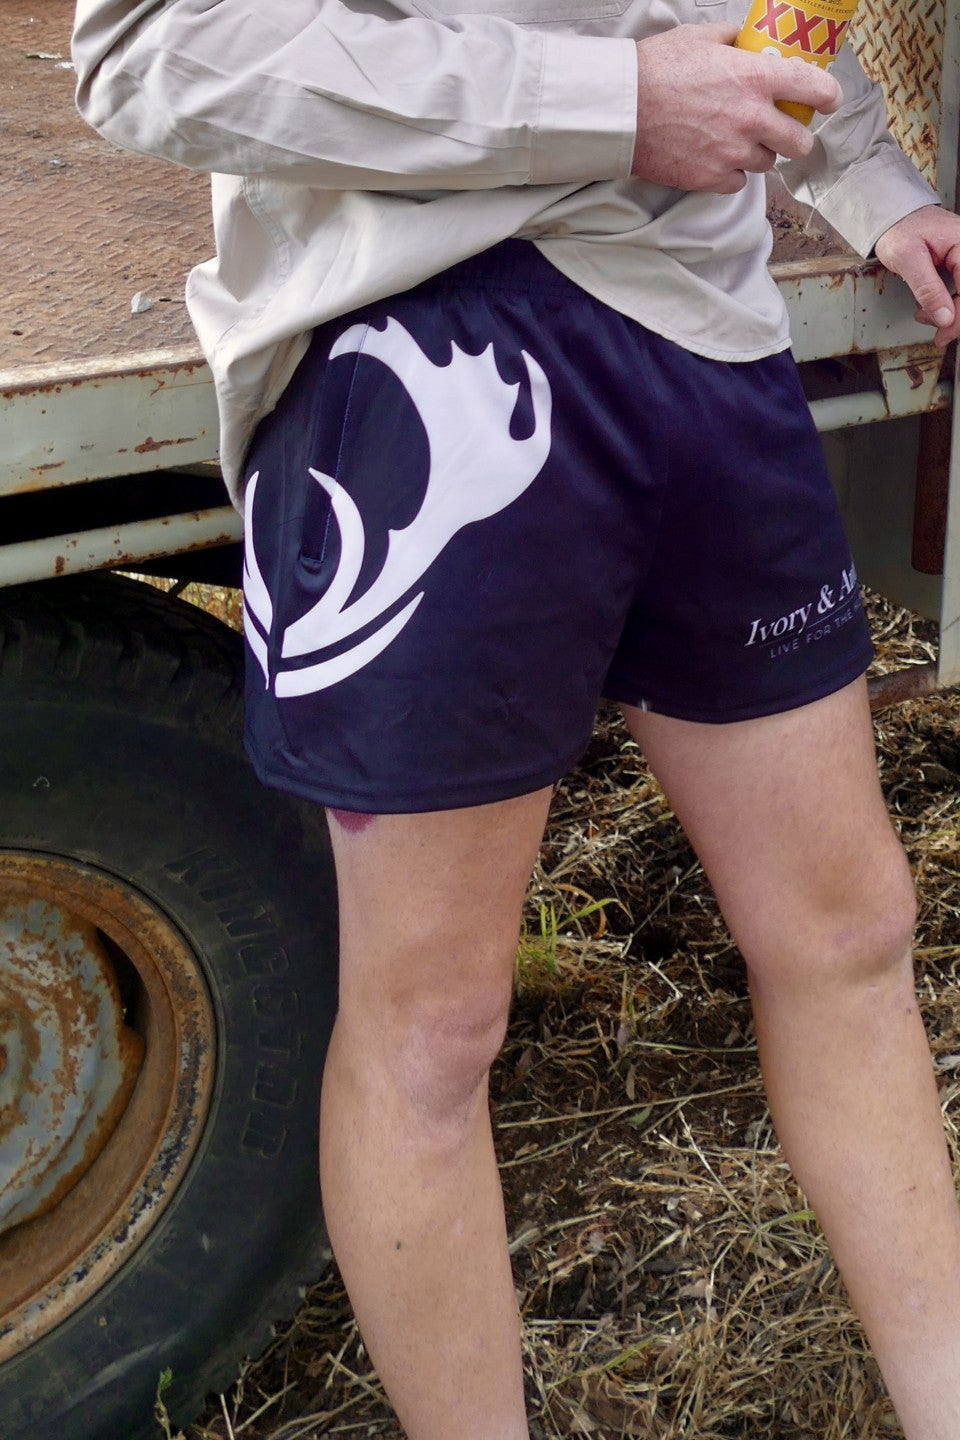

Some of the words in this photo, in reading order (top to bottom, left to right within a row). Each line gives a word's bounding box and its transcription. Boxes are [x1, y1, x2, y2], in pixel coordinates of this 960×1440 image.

[744, 603, 813, 647] Ivory
[817, 584, 836, 615] &
[769, 638, 800, 659] LIVE
[806, 624, 832, 644] FOR
